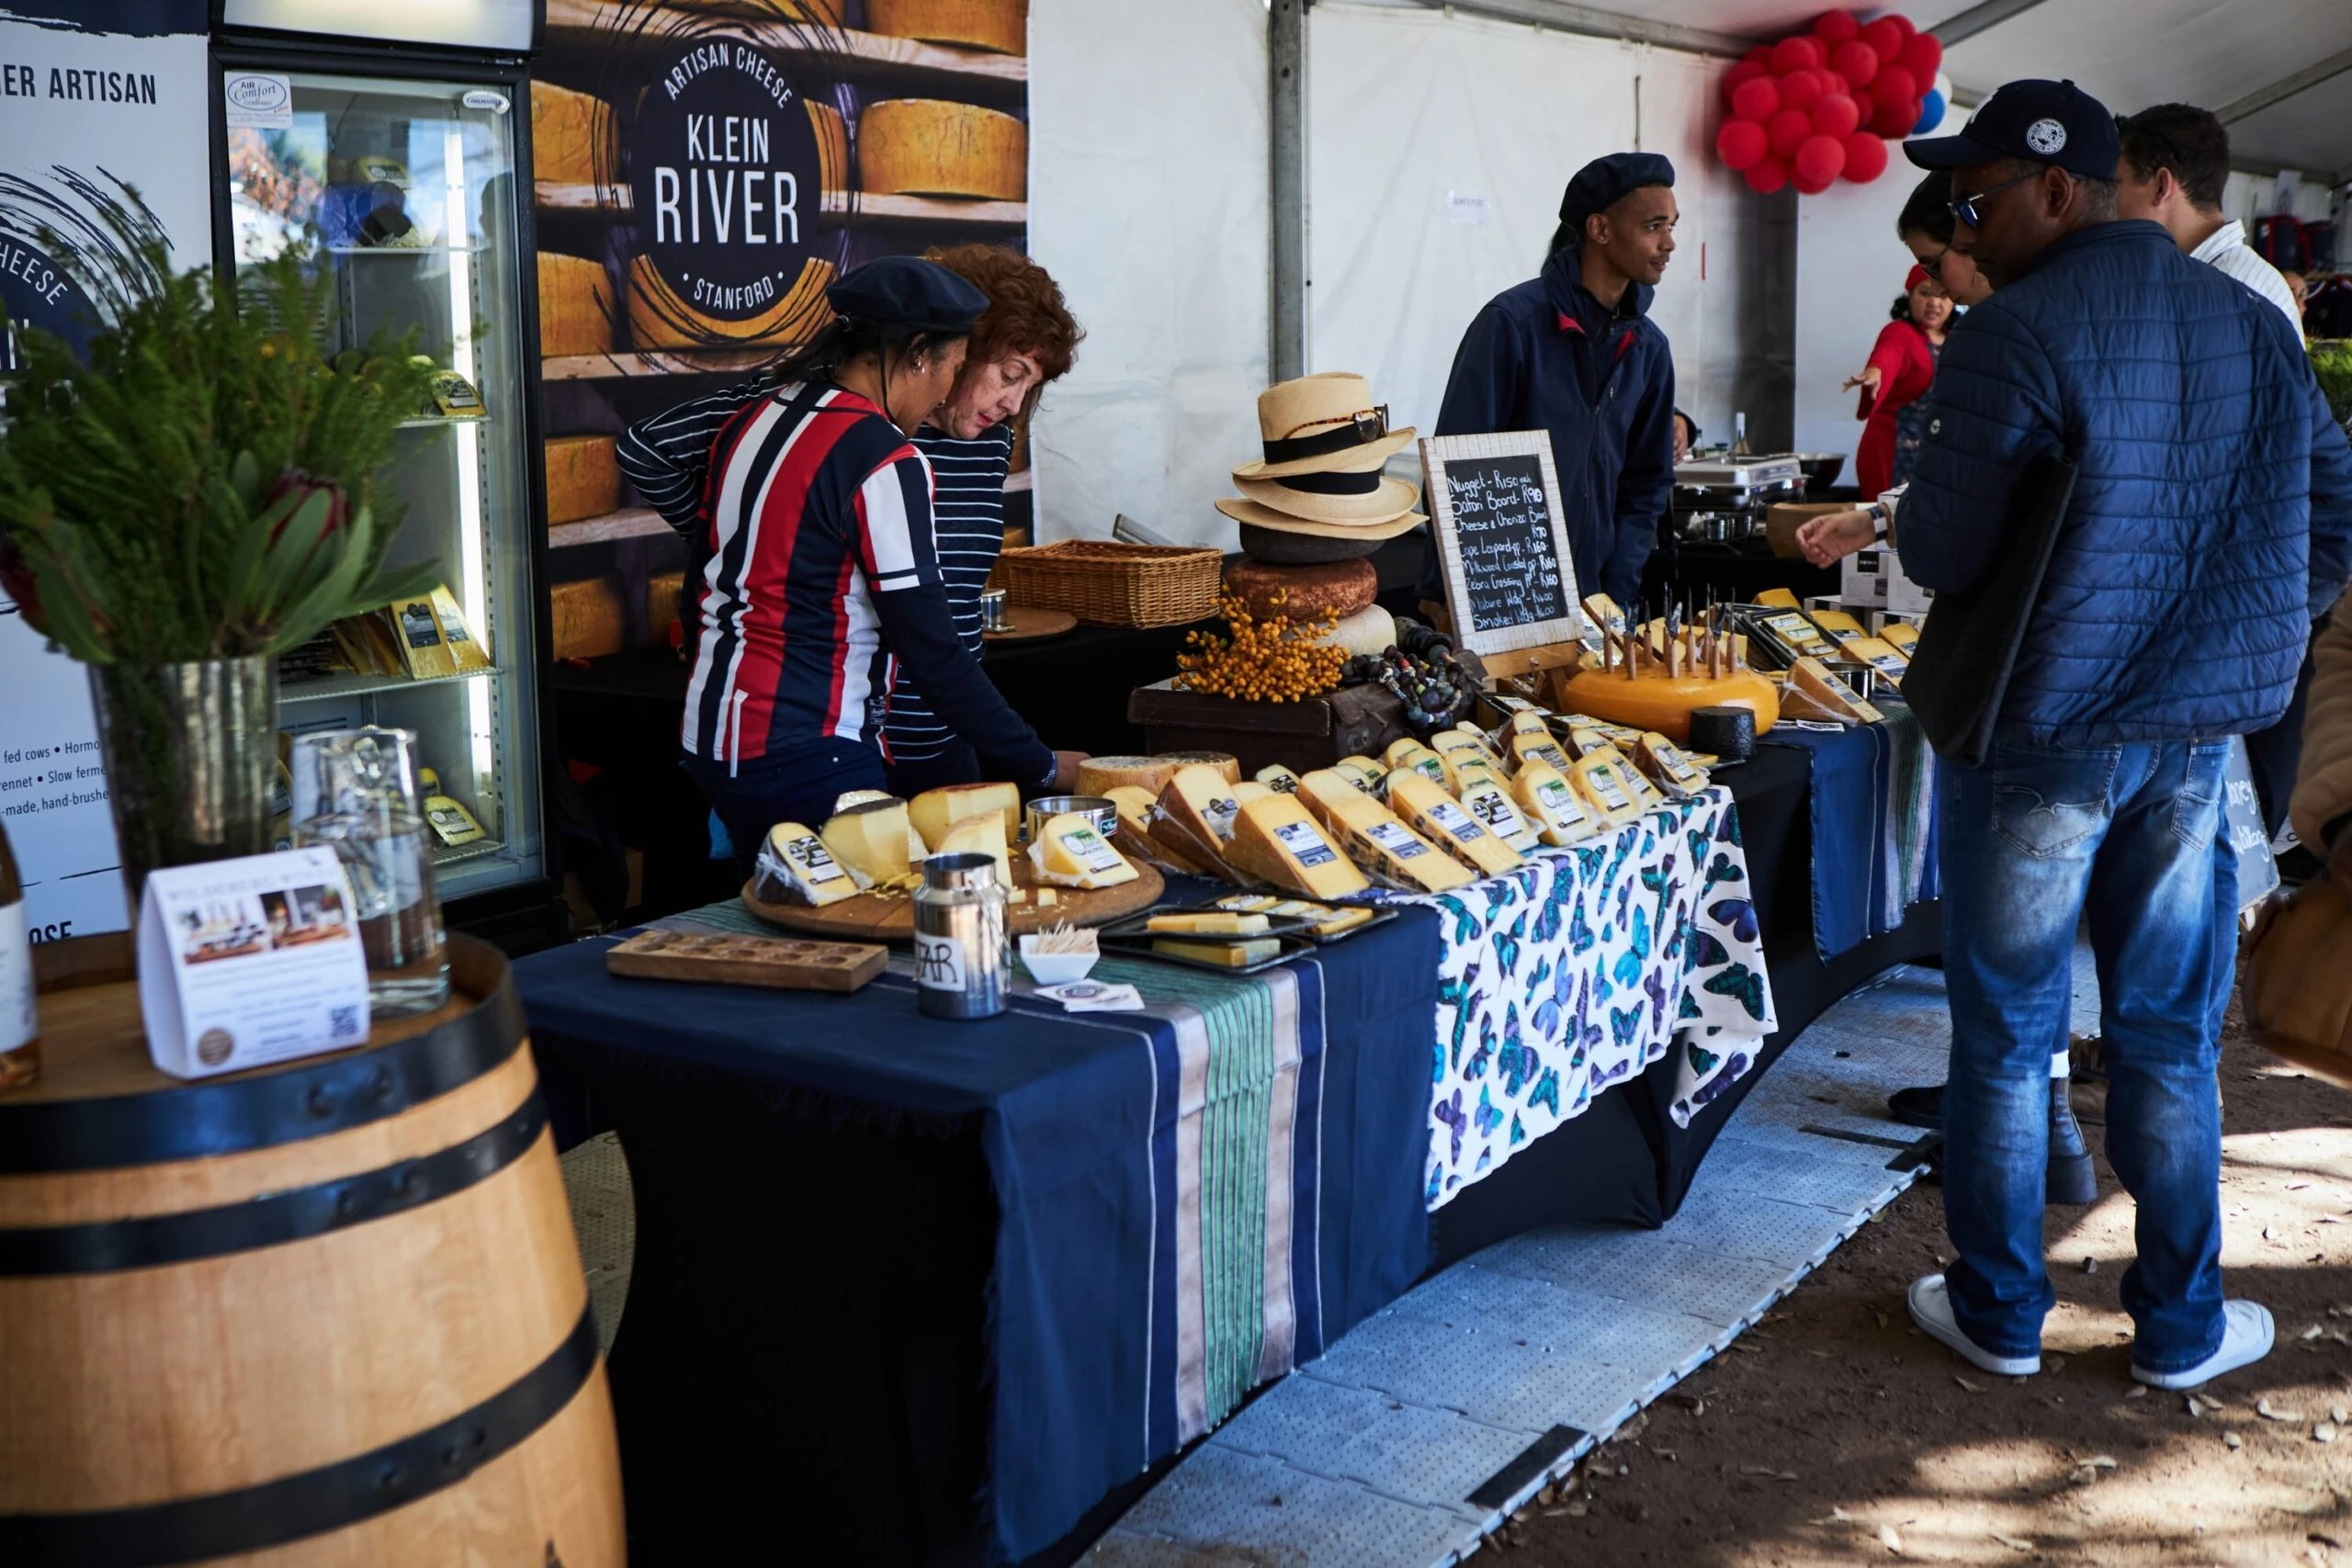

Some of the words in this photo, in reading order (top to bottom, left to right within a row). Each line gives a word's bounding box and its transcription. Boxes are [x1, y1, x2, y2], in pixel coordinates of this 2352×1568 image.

[0, 64, 36, 97] ER
[49, 68, 156, 105] ARTISAN
[663, 43, 729, 102] ARTISAN
[736, 46, 793, 109] CHEESE
[234, 85, 276, 101] Comfort
[687, 114, 770, 164] KLEIN
[655, 166, 799, 244] RIVER
[694, 276, 775, 311] STANFORD
[1447, 471, 1487, 498] Nugget
[1493, 469, 1519, 490] R150
[1450, 492, 1484, 515] Safari
[1453, 516, 1489, 534] Cheese
[1532, 524, 1547, 538] R70
[4, 750, 21, 763] fed
[25, 748, 51, 761] cows
[0, 775, 33, 791] ennet
[48, 770, 73, 784] Slow
